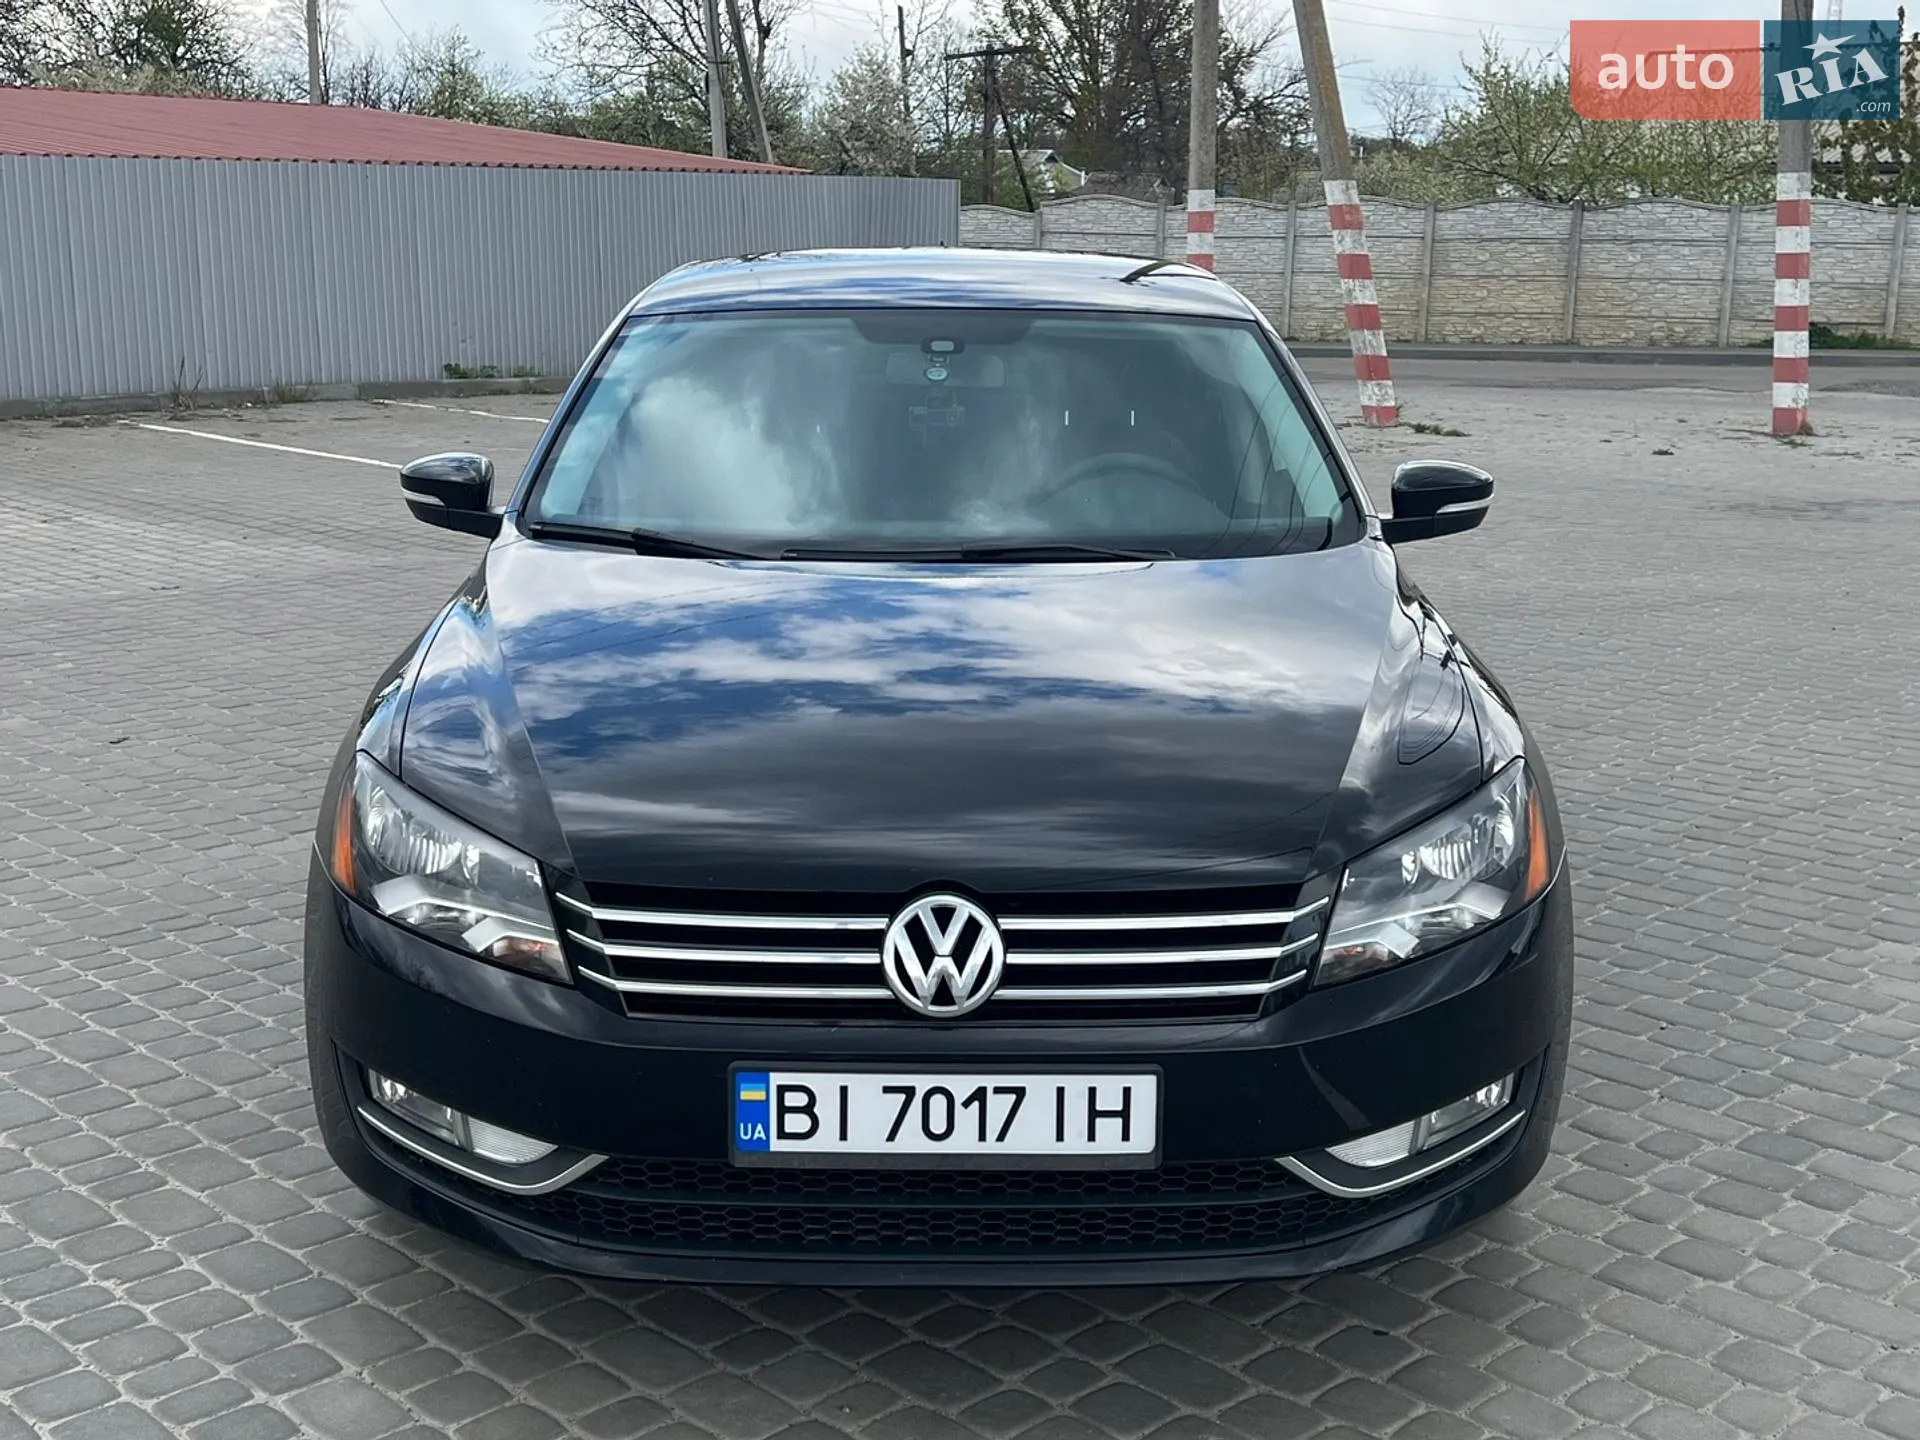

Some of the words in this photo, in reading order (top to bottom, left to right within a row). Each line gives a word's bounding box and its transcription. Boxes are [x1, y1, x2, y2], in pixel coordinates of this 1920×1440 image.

[740, 1123, 767, 1141] UA
[776, 1084, 848, 1142] BI
[882, 1085, 1026, 1143] 7017
[1055, 1086, 1132, 1143] IH
